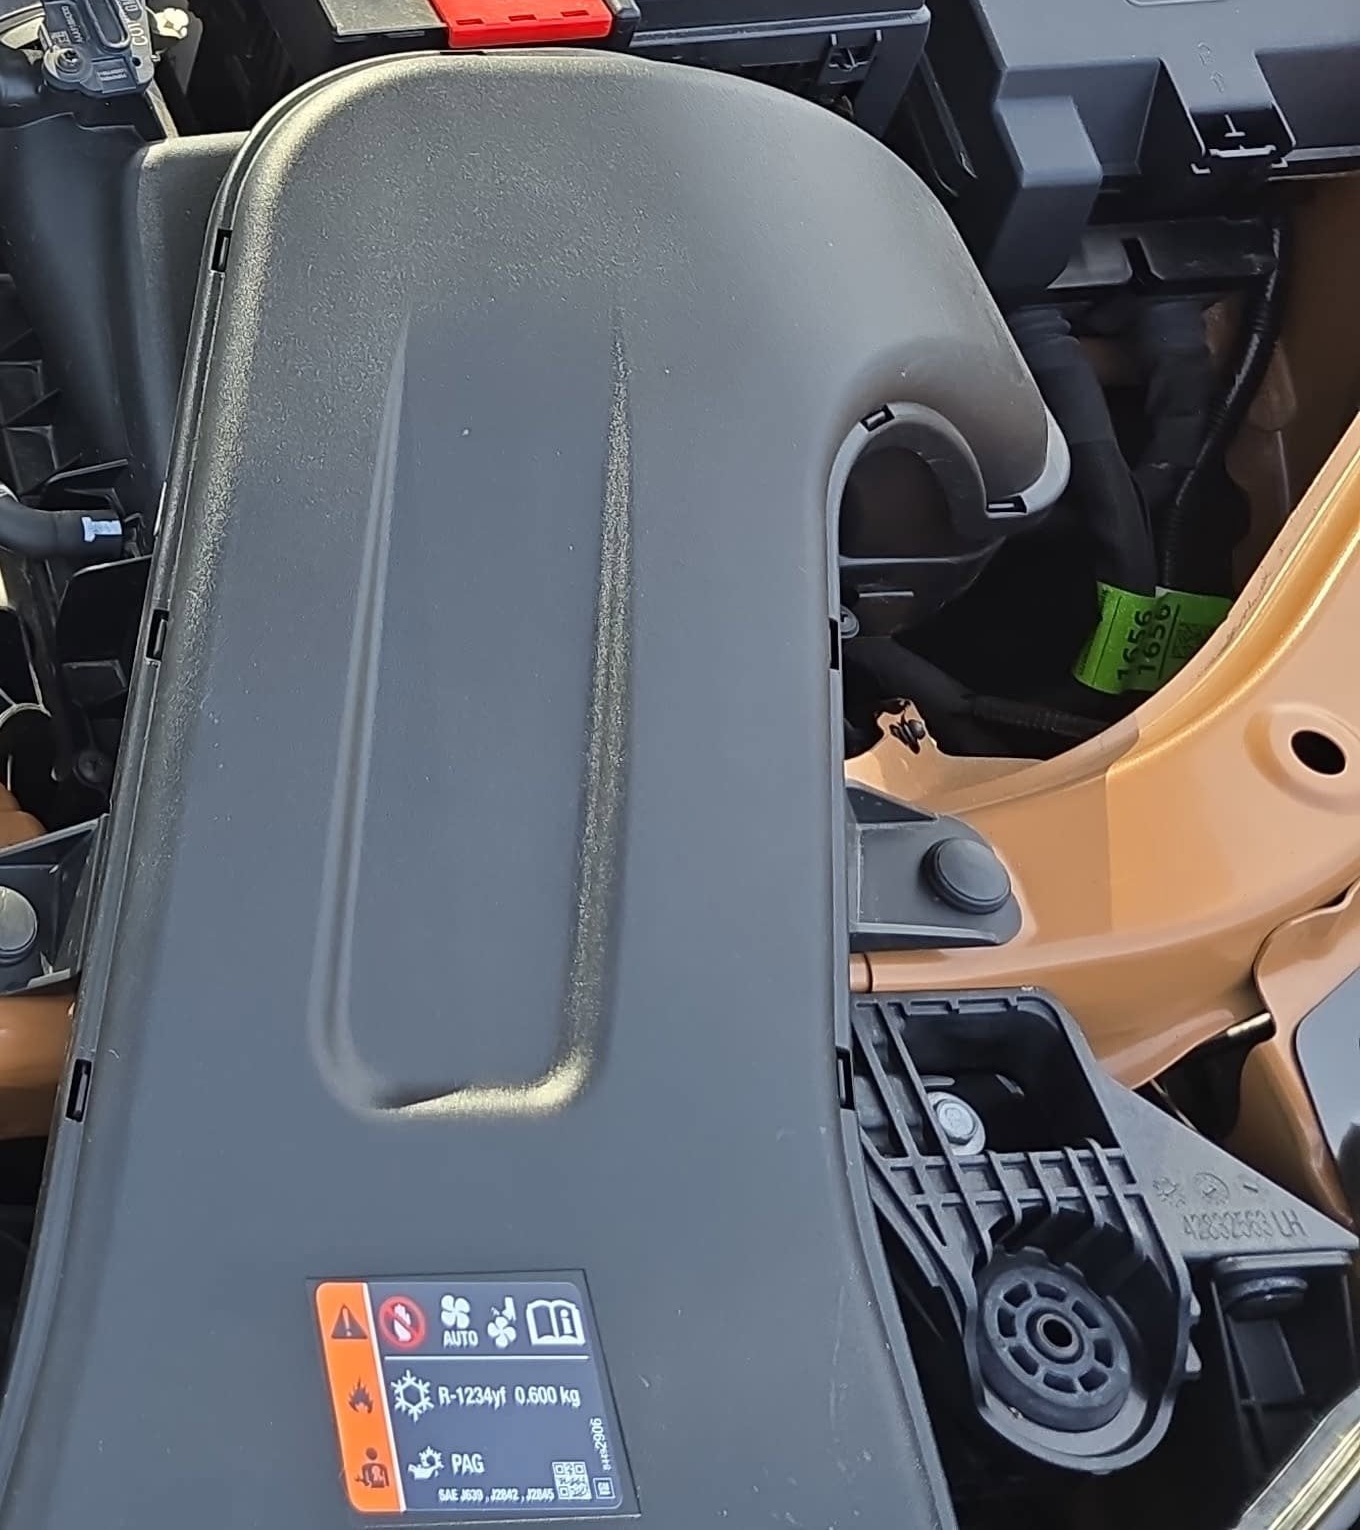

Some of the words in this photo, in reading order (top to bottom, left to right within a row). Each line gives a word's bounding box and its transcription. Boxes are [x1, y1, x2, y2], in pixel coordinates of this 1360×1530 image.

[443, 1330, 479, 1347] AUTO
[438, 1386, 507, 1410] R-1234yf
[515, 1386, 557, 1405] 0.600
[561, 1386, 581, 1408] kg
[451, 1453, 484, 1474] PAG
[438, 1488, 458, 1502] SAE
